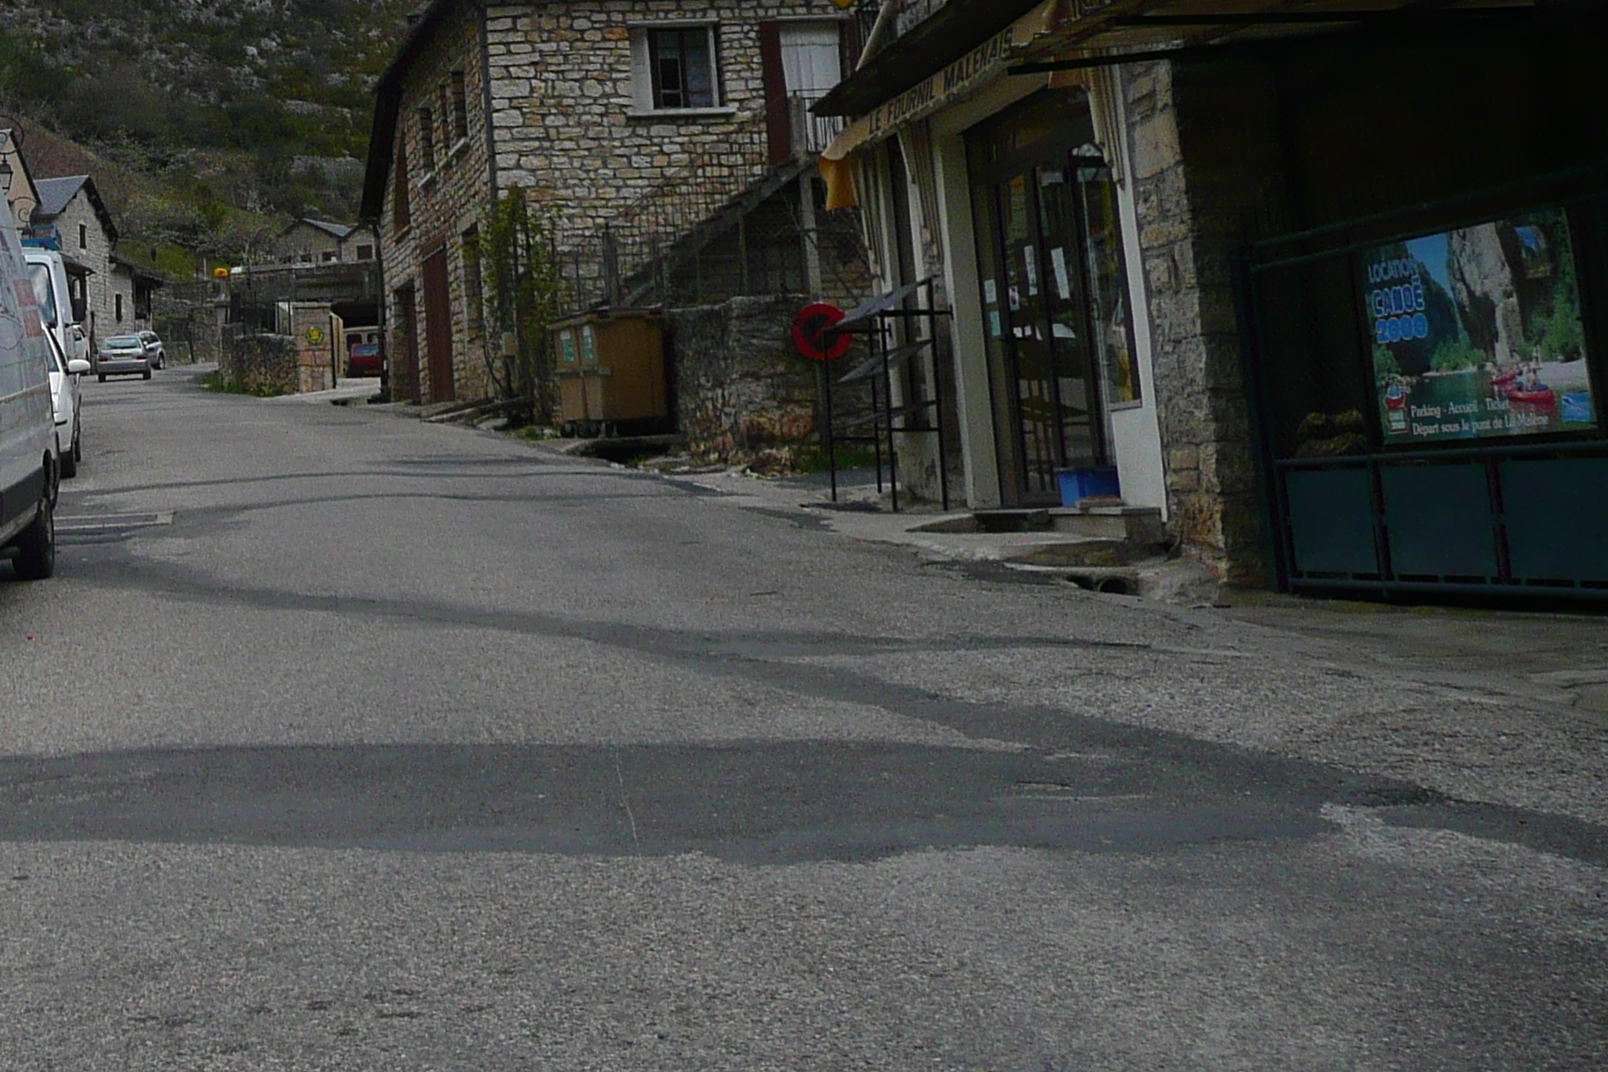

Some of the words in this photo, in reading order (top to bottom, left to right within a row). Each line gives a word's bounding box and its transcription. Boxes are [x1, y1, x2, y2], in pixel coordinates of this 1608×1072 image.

[870, 108, 882, 136] LE
[887, 77, 935, 126] FOURNIL
[1367, 258, 1419, 283] LOCATION
[1375, 312, 1428, 344] 2000
[1410, 403, 1441, 418] Parking
[1448, 400, 1478, 415] Accueil
[1412, 422, 1439, 437] Départ
[1441, 422, 1460, 433] sous
[1461, 418, 1470, 431] le
[1492, 415, 1503, 429] de
